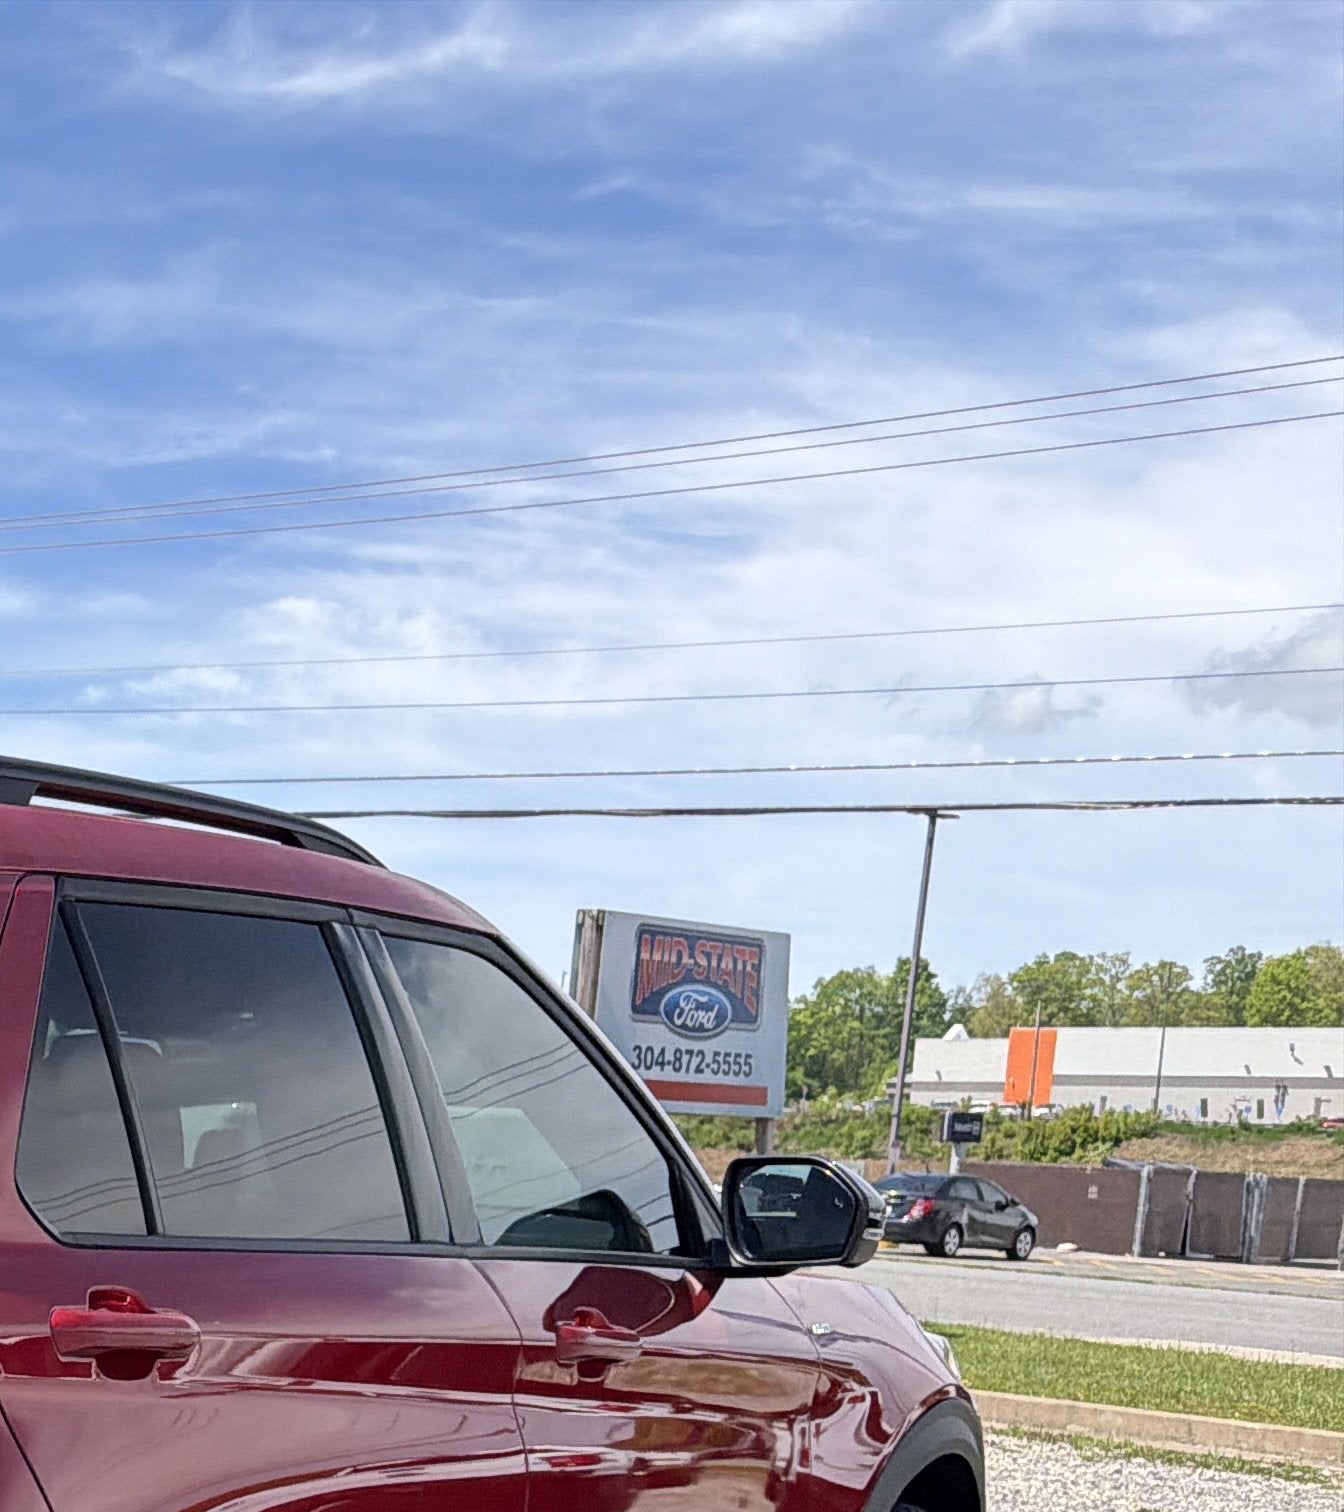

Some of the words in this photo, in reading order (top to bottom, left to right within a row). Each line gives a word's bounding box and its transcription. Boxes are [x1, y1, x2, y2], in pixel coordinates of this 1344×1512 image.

[636, 934, 760, 1016] MID-STATE
[673, 992, 719, 1029] Ford
[631, 1045, 754, 1078] 304-872-5555
